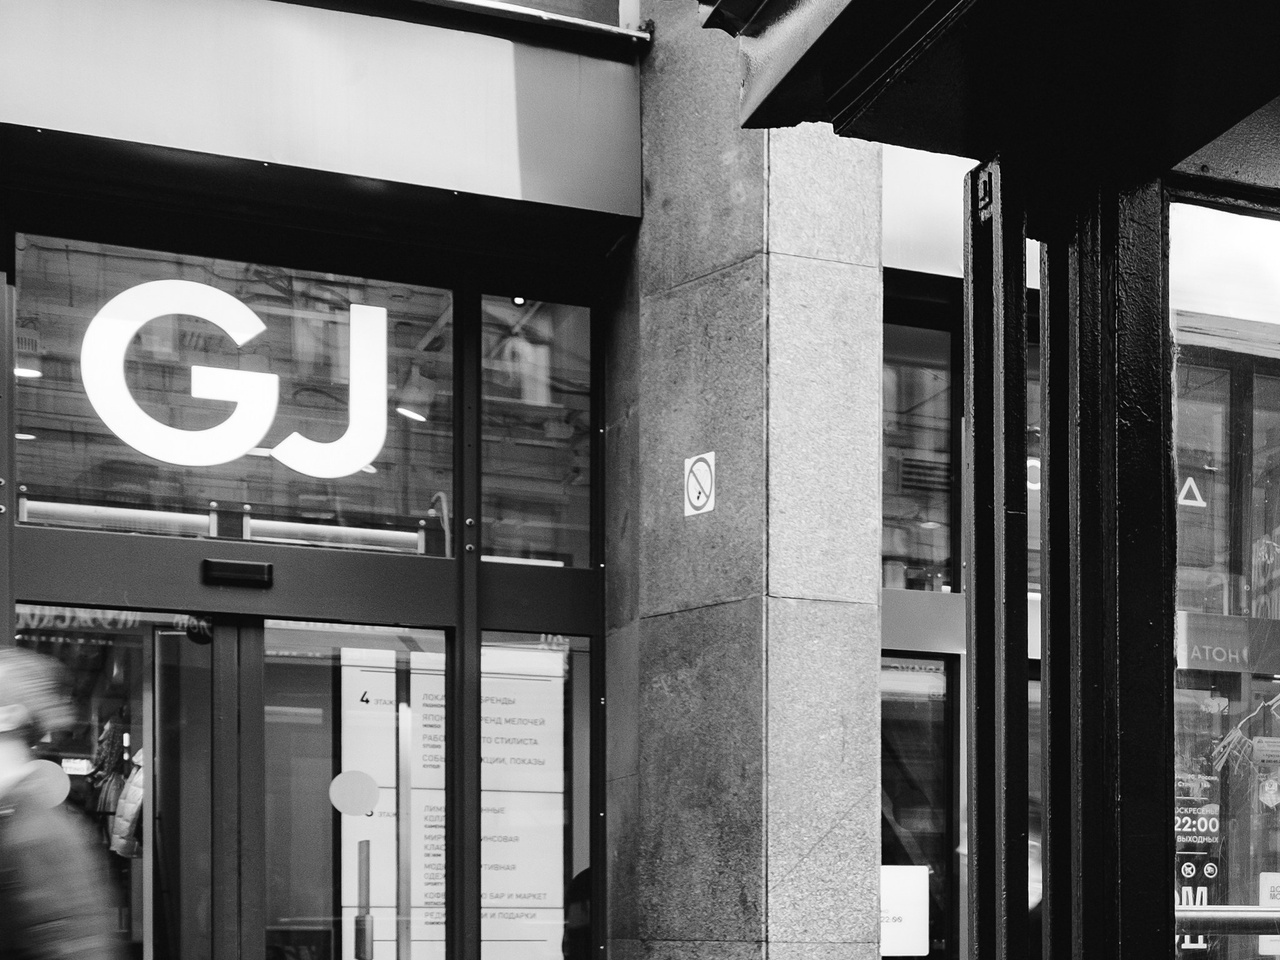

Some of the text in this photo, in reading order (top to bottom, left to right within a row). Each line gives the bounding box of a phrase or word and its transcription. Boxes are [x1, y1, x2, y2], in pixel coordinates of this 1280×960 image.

[81, 279, 388, 479] GJ
[360, 691, 370, 705] 4
[504, 717, 546, 726] МЕЛОЧЕЙ
[494, 736, 539, 746] СТИЛИСТА
[510, 757, 546, 766] ПОКАЗЫ
[1175, 817, 1219, 833] 22:00
[1177, 835, 1219, 844] ВЫХОДНЫХ
[489, 892, 505, 900] БАР
[507, 892, 514, 900] И
[515, 892, 547, 901] МАРКЕТ
[498, 912, 537, 920] ПОДАРКИ
